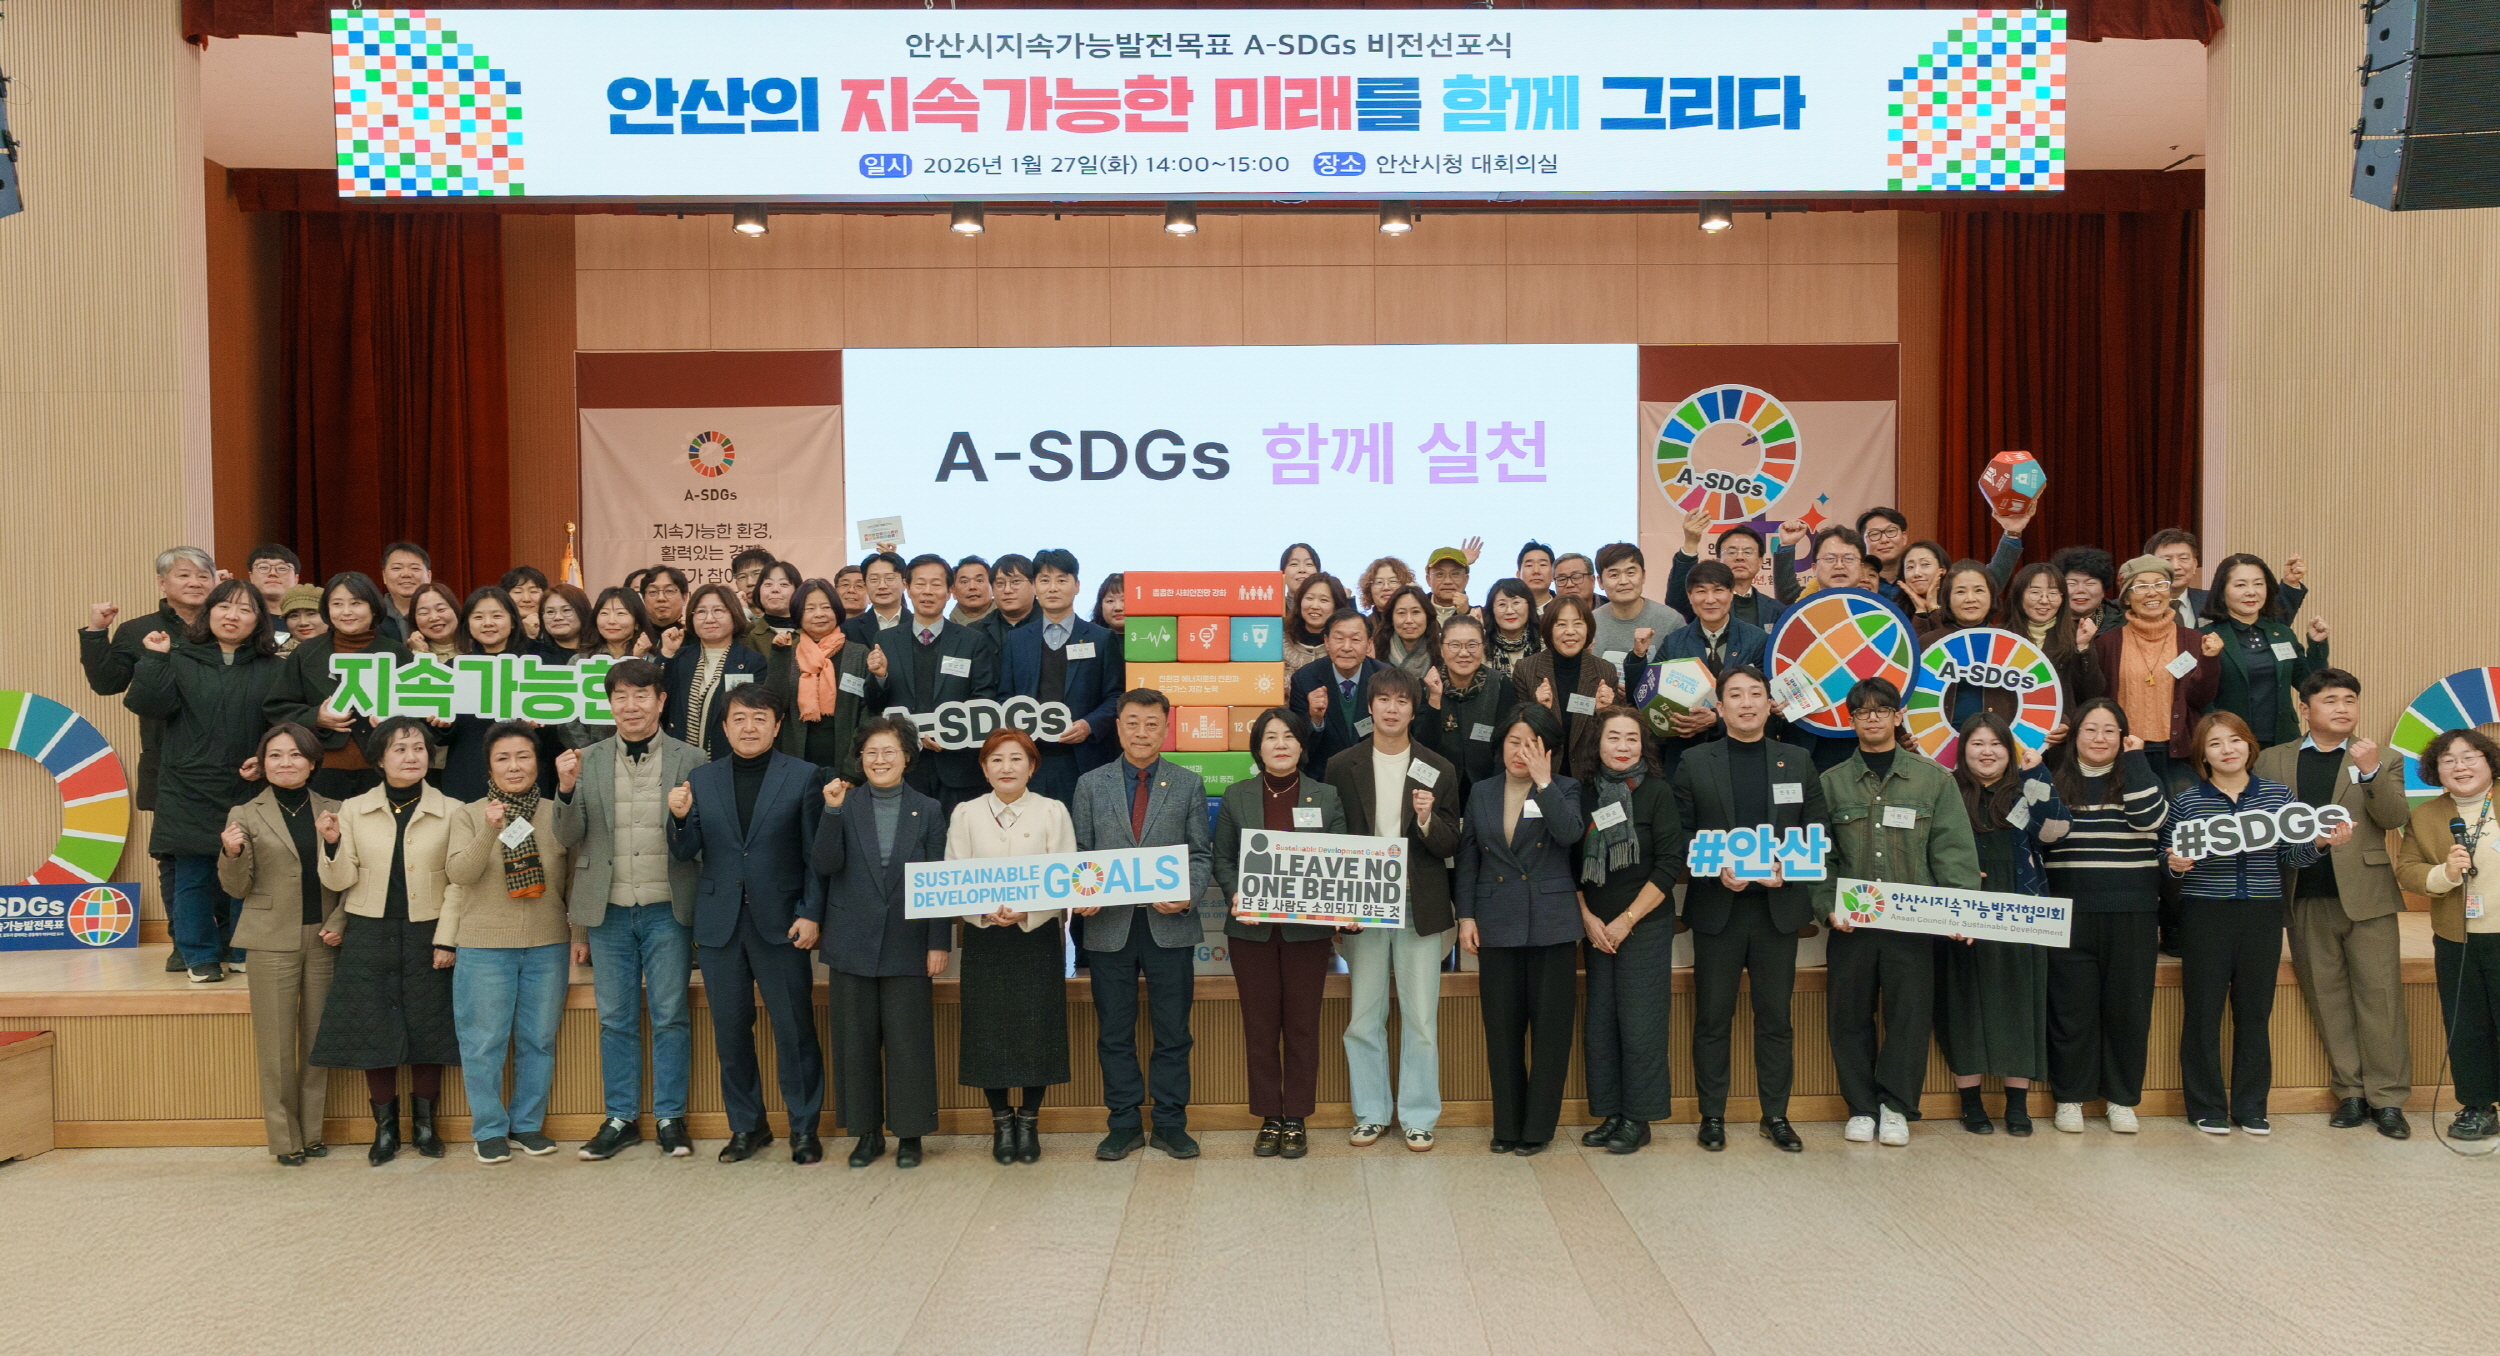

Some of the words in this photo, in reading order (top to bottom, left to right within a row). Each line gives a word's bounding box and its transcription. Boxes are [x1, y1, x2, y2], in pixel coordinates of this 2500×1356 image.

[906, 32, 1233, 59] 안산시지속가능발전목표
[1244, 34, 1356, 56] A-SDGs
[1367, 32, 1511, 58] 비전선포식
[606, 76, 819, 135] 안산의
[840, 74, 1194, 134] 지속가능한
[1214, 75, 1422, 132] 미래를
[1442, 74, 1579, 132] 함께
[1599, 74, 1807, 132] 그리다
[865, 154, 909, 177] 일시
[923, 155, 1002, 175] 2026년
[1011, 154, 1043, 175] 1월
[1050, 154, 1139, 176] 27일(화)
[1145, 155, 1290, 173] 14:00~15:00
[1317, 153, 1363, 175] 장소
[1376, 153, 1463, 175] 안산시청
[1471, 153, 1558, 174] 대회의실
[935, 428, 1231, 484] A-SDGs
[1262, 420, 1395, 485] 함께
[1417, 419, 1547, 485] 실천
[1675, 466, 1764, 498] A-SDGs
[684, 489, 737, 502] A-SDGs
[653, 522, 732, 540] 지속가능한
[736, 522, 772, 540] 환경,
[660, 545, 724, 561] 활력있는
[1135, 586, 1142, 600] 1
[1131, 632, 1137, 642] 3
[1189, 632, 1196, 642] 5
[1242, 632, 1249, 642] 6
[1938, 661, 2036, 689] A-SDGs
[888, 701, 1067, 744] -SDGs
[1181, 722, 1189, 733] 11
[1234, 722, 1244, 732] 12
[2176, 805, 2349, 859] #SDGs
[1275, 843, 1317, 853] Sustainable
[1318, 846, 1364, 856] Development
[1365, 848, 1385, 857] Goals
[1690, 826, 1827, 879] #안산
[913, 864, 1040, 888] SUSTAINABLE
[1043, 854, 1180, 899] GOALS
[1273, 853, 1359, 879] LEAVE
[1364, 858, 1402, 882] NO
[913, 884, 1040, 908] DEVELOPMENT
[1242, 875, 1296, 899] ONE
[1302, 877, 1401, 904] BEHIND
[1257, 898, 1269, 911] 한
[1272, 899, 1307, 913] 사람도
[1311, 901, 1358, 916] 소외되지
[1362, 903, 1385, 917] 않는
[1389, 905, 1400, 918] 것
[1891, 892, 2065, 924] 안산시지속가능발전협의회
[1890, 913, 1915, 922] Ansan
[1917, 916, 1947, 926] Council
[1948, 918, 1960, 927] for
[1961, 920, 2008, 931] Sustainable
[2010, 925, 2063, 937] Development
